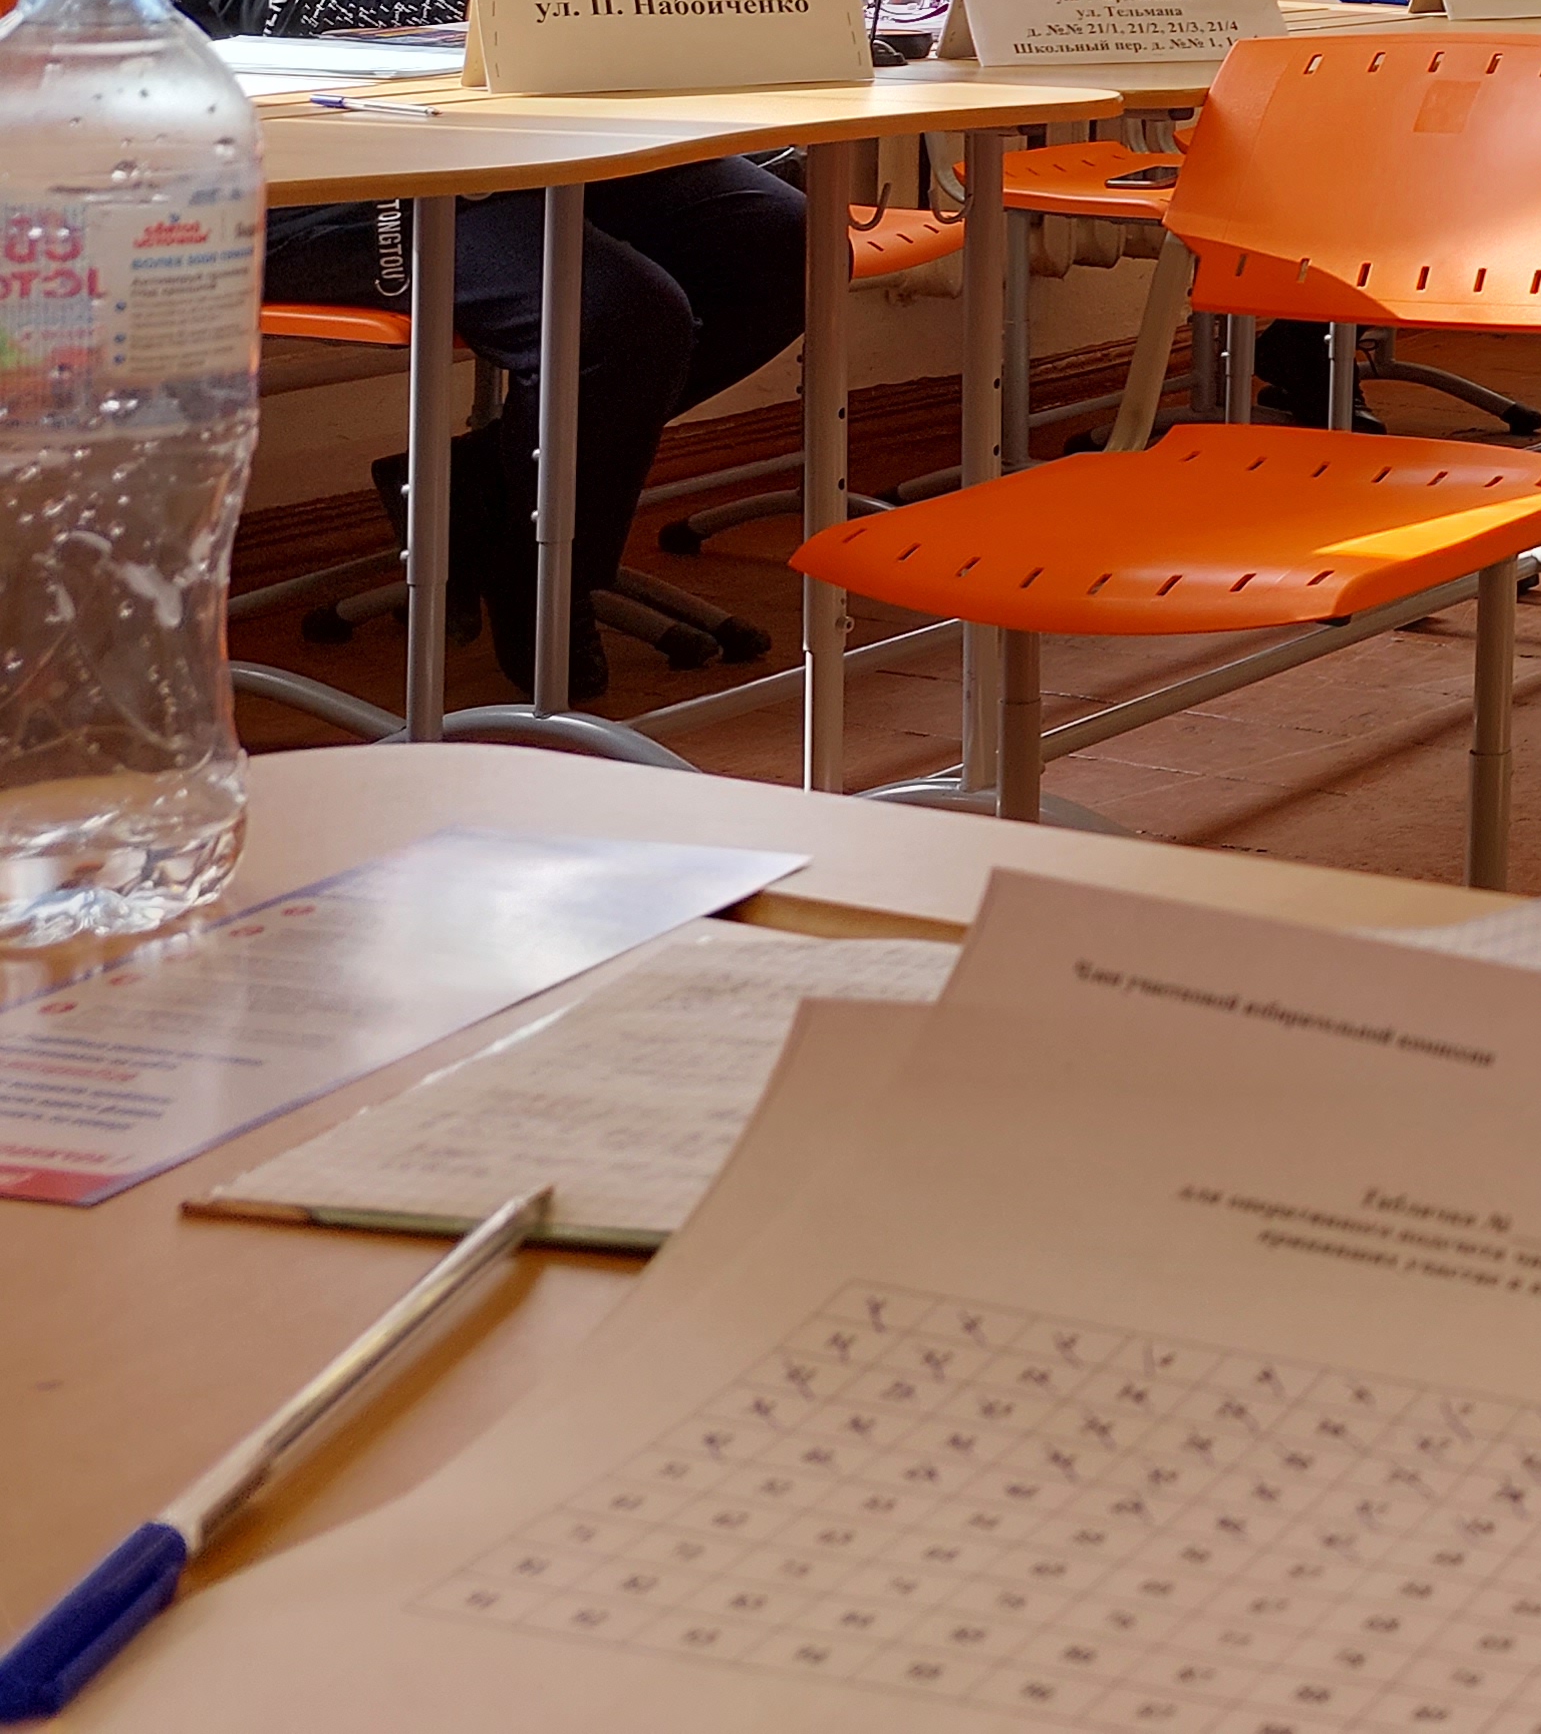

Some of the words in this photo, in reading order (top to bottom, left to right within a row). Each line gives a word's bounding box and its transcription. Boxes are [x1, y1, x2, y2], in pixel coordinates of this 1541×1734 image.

[535, 0, 580, 23] ул.
[1076, 8, 1101, 20] ул.
[1105, 6, 1183, 17] Тельмана
[1088, 23, 1125, 35] 21/1,
[1128, 23, 1165, 35] 21/2,
[1168, 21, 1205, 34] 21/3,
[1207, 21, 1239, 32] 21/4
[1013, 38, 1111, 55] Школьный
[1115, 41, 1148, 53] пер.
